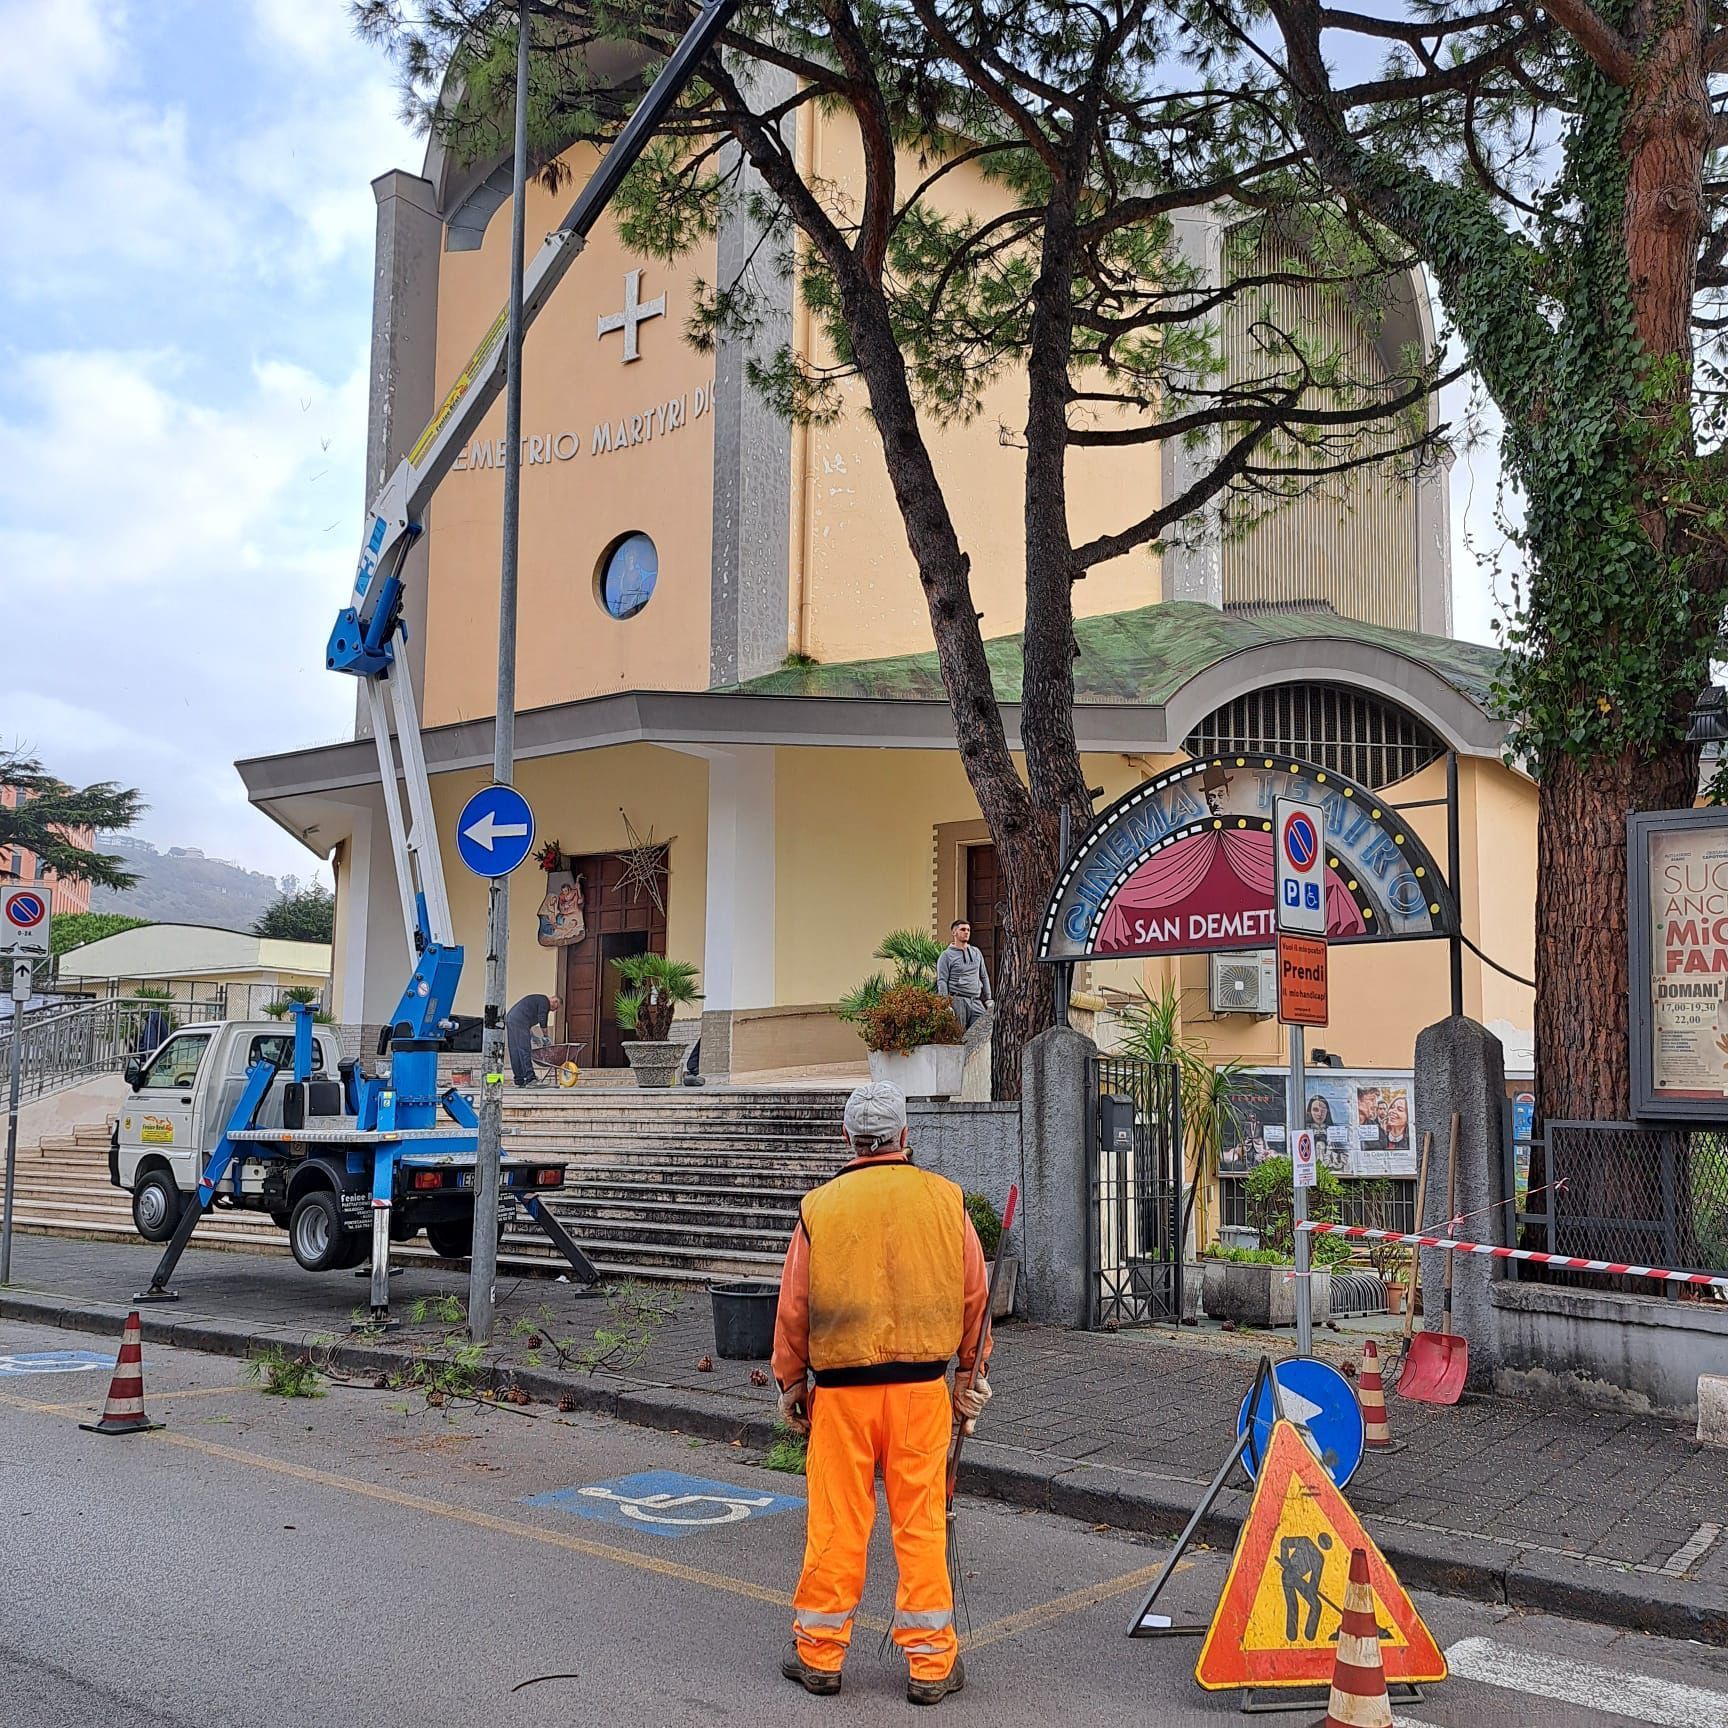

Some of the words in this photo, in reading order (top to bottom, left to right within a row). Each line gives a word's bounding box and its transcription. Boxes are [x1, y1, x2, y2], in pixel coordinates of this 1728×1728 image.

[452, 432, 580, 471] EMETRIO
[592, 393, 687, 456] MARTYRI
[1063, 785, 1198, 941] CINEMA
[1252, 770, 1427, 914] TEATRO
[1287, 881, 1297, 904] P
[1664, 894, 1728, 917] ANC
[1134, 916, 1180, 944] SAN
[1283, 960, 1324, 982] Prendi
[1658, 984, 1718, 998] DOMANI
[1661, 1003, 1716, 1013] 17,00-19,30
[1675, 1015, 1701, 1025] 22,00
